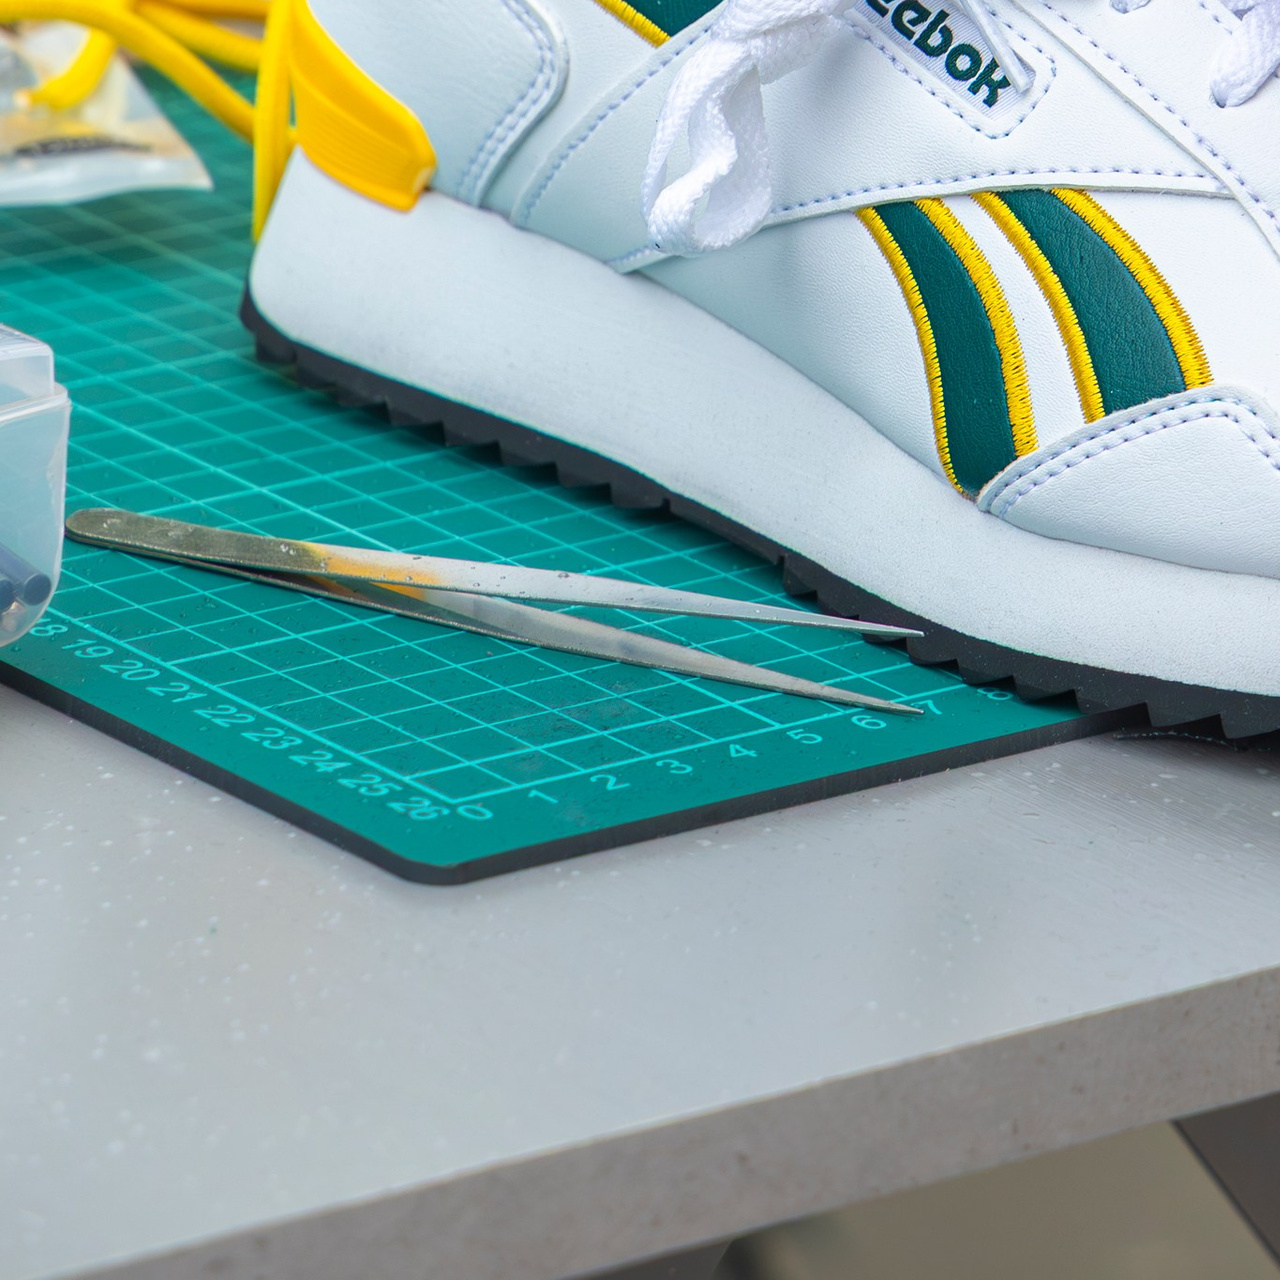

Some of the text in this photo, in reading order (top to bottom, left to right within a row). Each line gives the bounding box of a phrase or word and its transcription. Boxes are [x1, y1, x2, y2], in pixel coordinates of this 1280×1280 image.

[61, 638, 115, 659] 19
[100, 659, 161, 681] 20
[146, 681, 208, 703] 21
[193, 704, 256, 728] 22
[240, 727, 303, 750] 23
[288, 750, 352, 773] 24
[337, 773, 403, 797] 25
[386, 796, 450, 821] 26
[456, 804, 494, 821] 0
[527, 789, 559, 804] 1
[589, 773, 631, 791] 2
[655, 758, 693, 775] 3
[728, 742, 758, 759] 4
[785, 728, 823, 745] 5
[850, 714, 887, 730] 6
